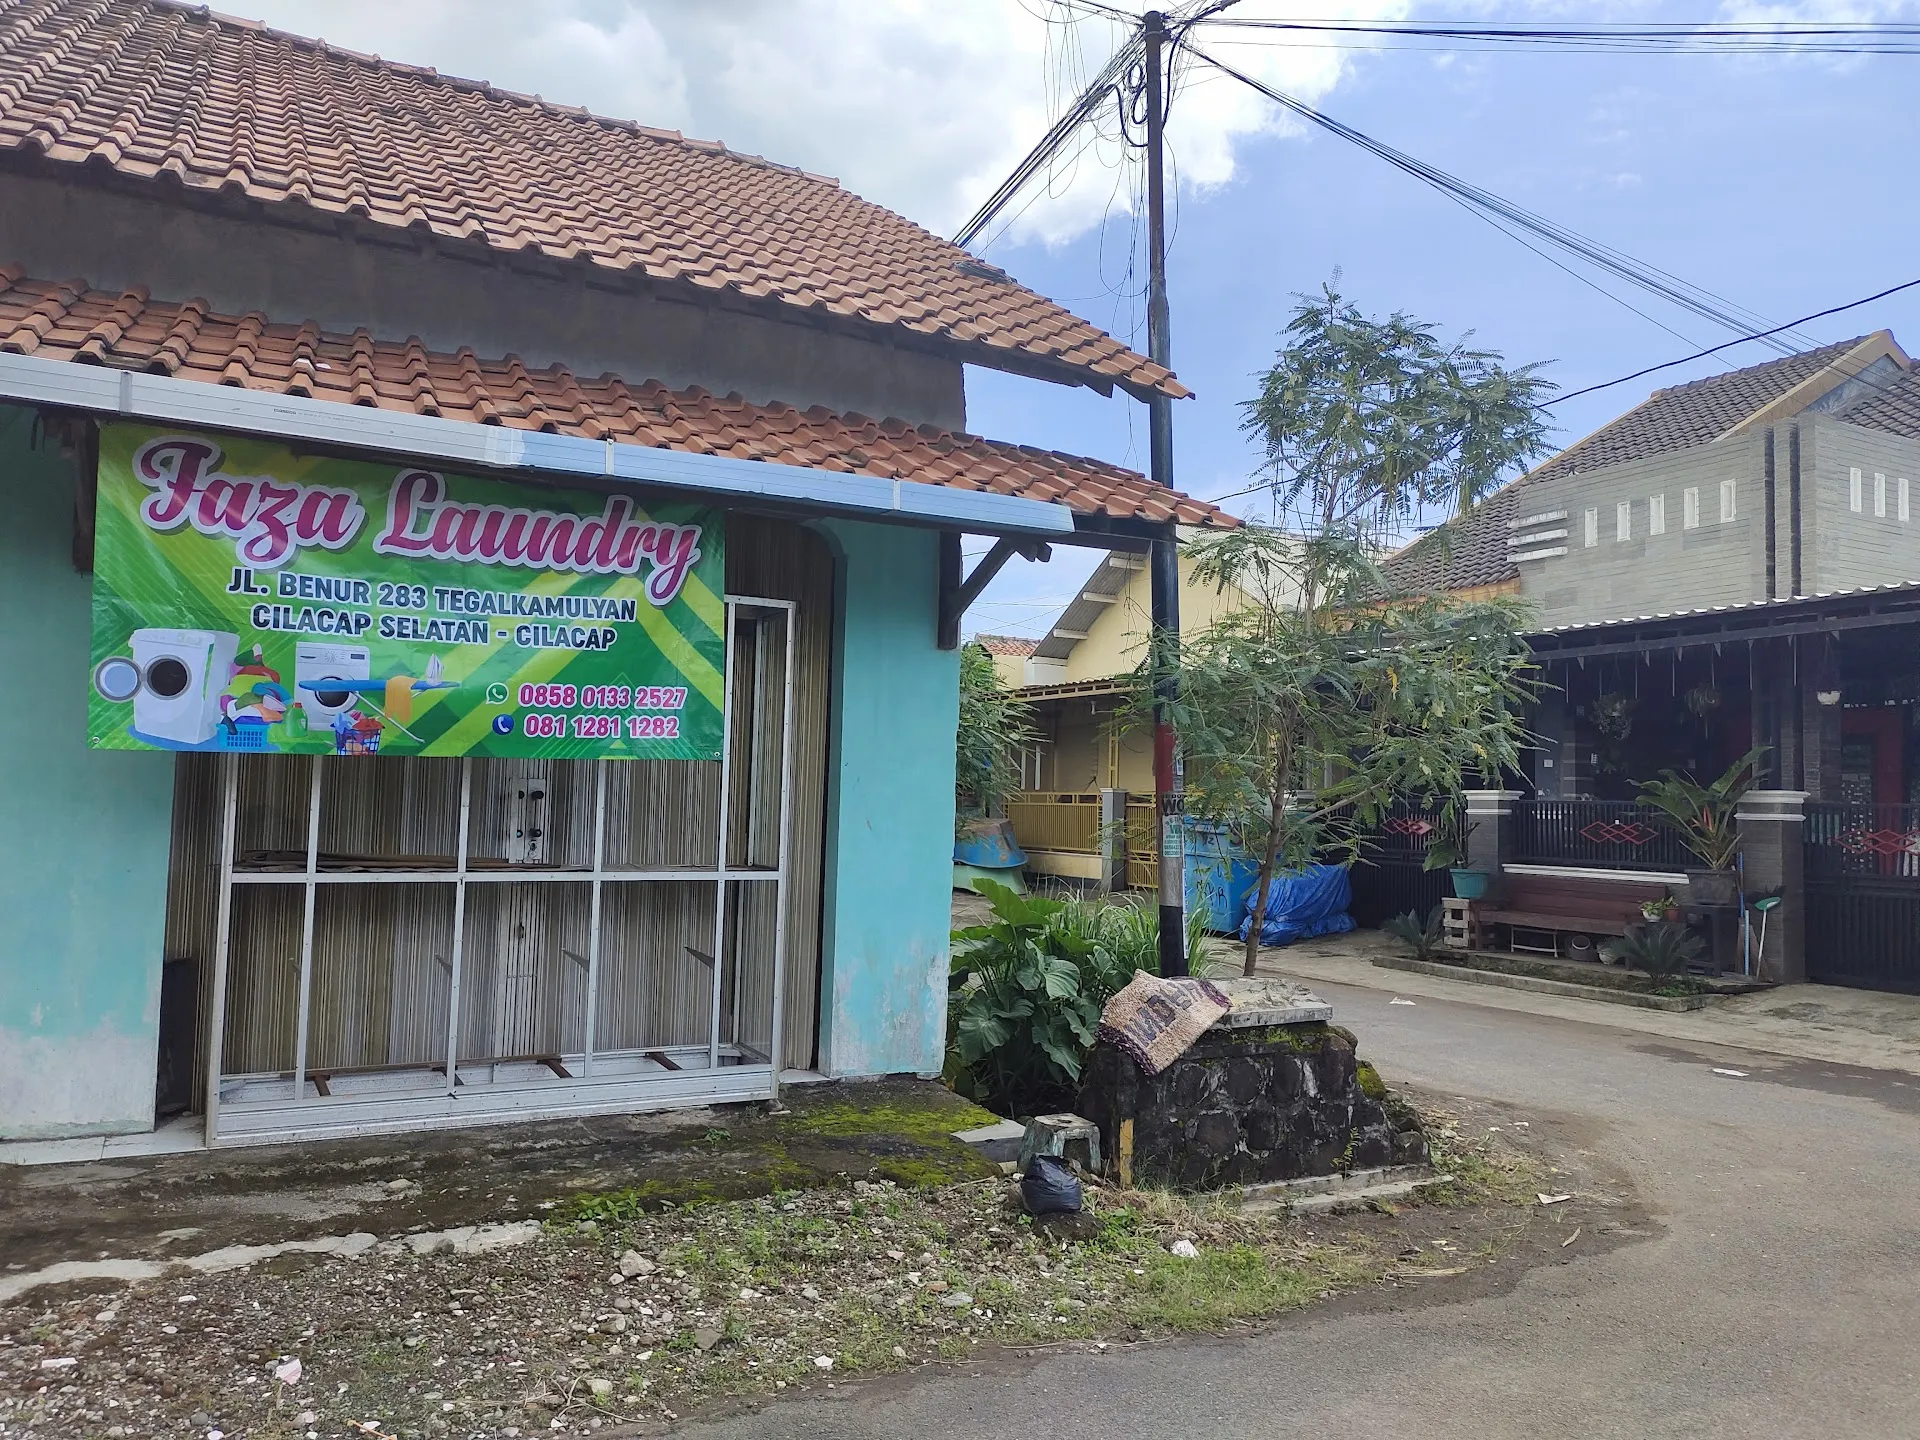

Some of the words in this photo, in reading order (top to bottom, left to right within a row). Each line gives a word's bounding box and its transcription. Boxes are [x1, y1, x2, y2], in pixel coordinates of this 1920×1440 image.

[134, 437, 363, 566] Faza
[376, 470, 700, 603] Laundry
[228, 568, 268, 594] JL.
[278, 573, 370, 604] BENUR
[378, 583, 427, 609] 283
[433, 587, 637, 621] TEGALKAMULYAN
[252, 604, 371, 635] CILACAP
[379, 615, 489, 644] SELATAN
[515, 624, 617, 649] CILACAP
[519, 684, 576, 707] 0858
[581, 686, 630, 708] 0133
[635, 687, 687, 709] 2527
[525, 715, 566, 738] 081
[572, 715, 620, 738] 1281
[627, 716, 679, 738] 1282
